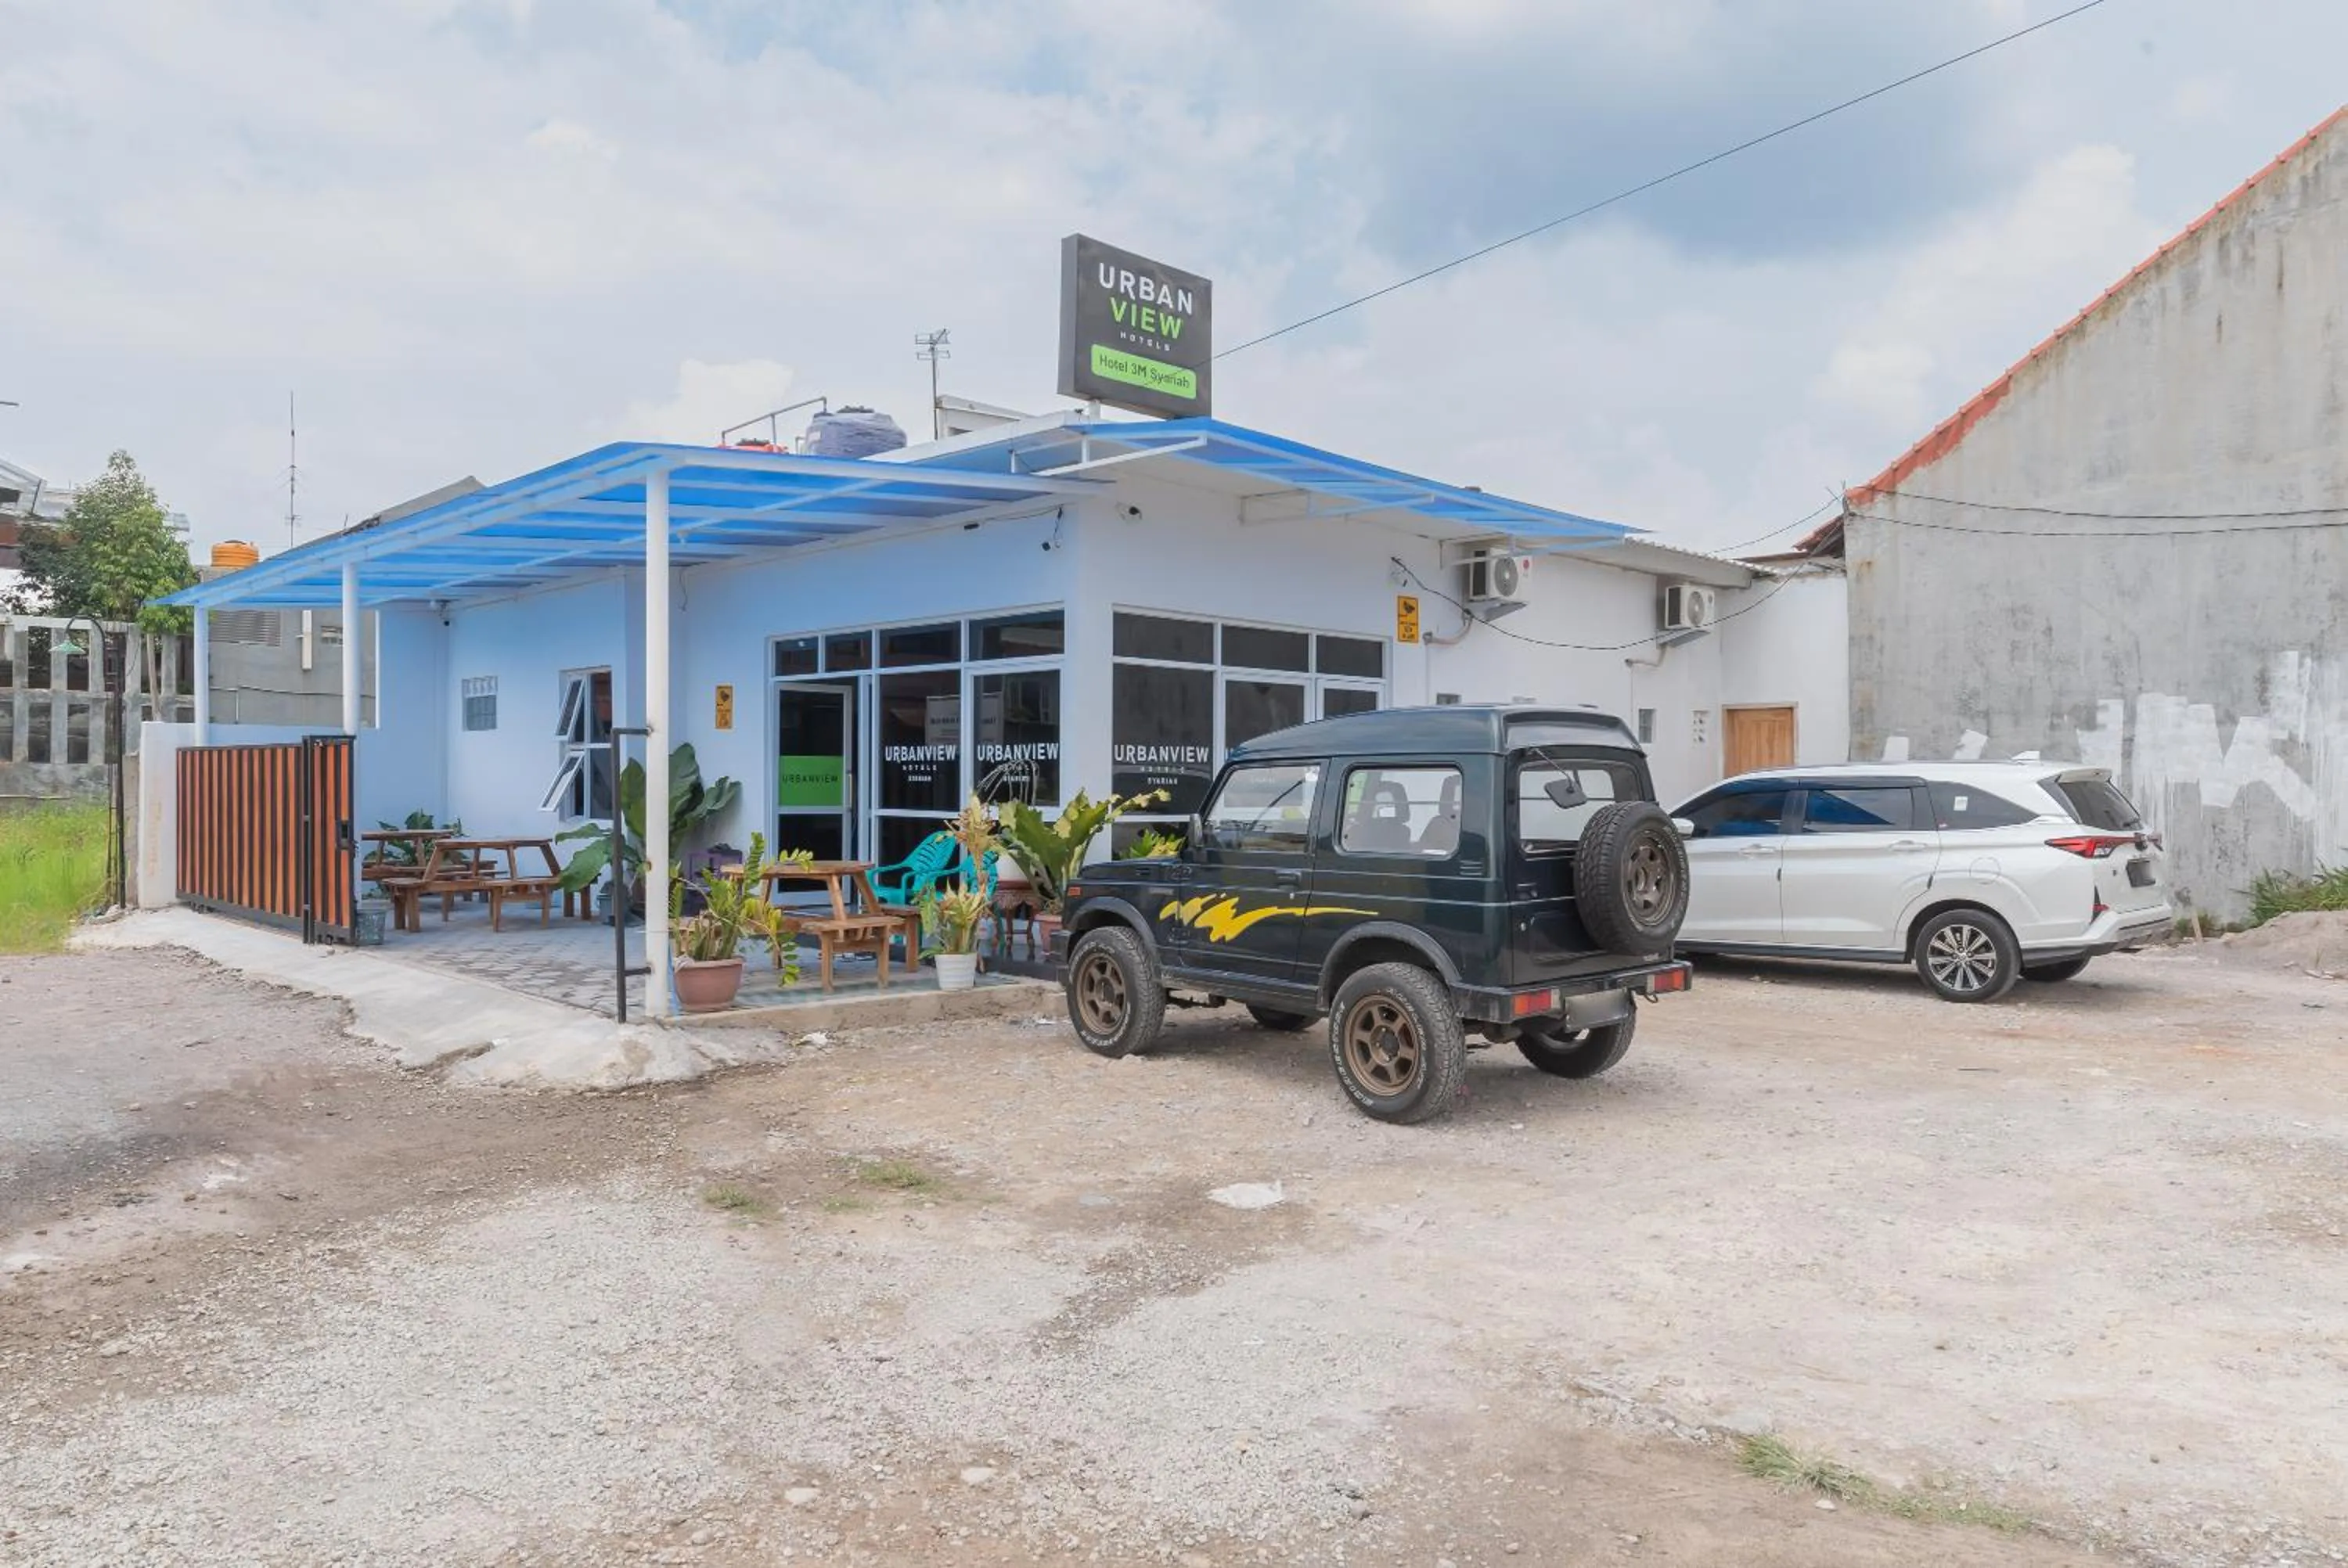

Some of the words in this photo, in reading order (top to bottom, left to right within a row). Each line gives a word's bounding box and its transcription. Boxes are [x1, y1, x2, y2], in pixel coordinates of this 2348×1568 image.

[1099, 262, 1193, 315] URBAN
[1109, 297, 1183, 339] VIEW
[1120, 331, 1171, 351] HOTELS
[1099, 354, 1129, 373] Hotel
[1130, 362, 1147, 378] 3M
[885, 745, 957, 764] URBANVIEW
[978, 743, 1059, 764] URBANVIEW
[1114, 744, 1209, 764] URBANVIEW
